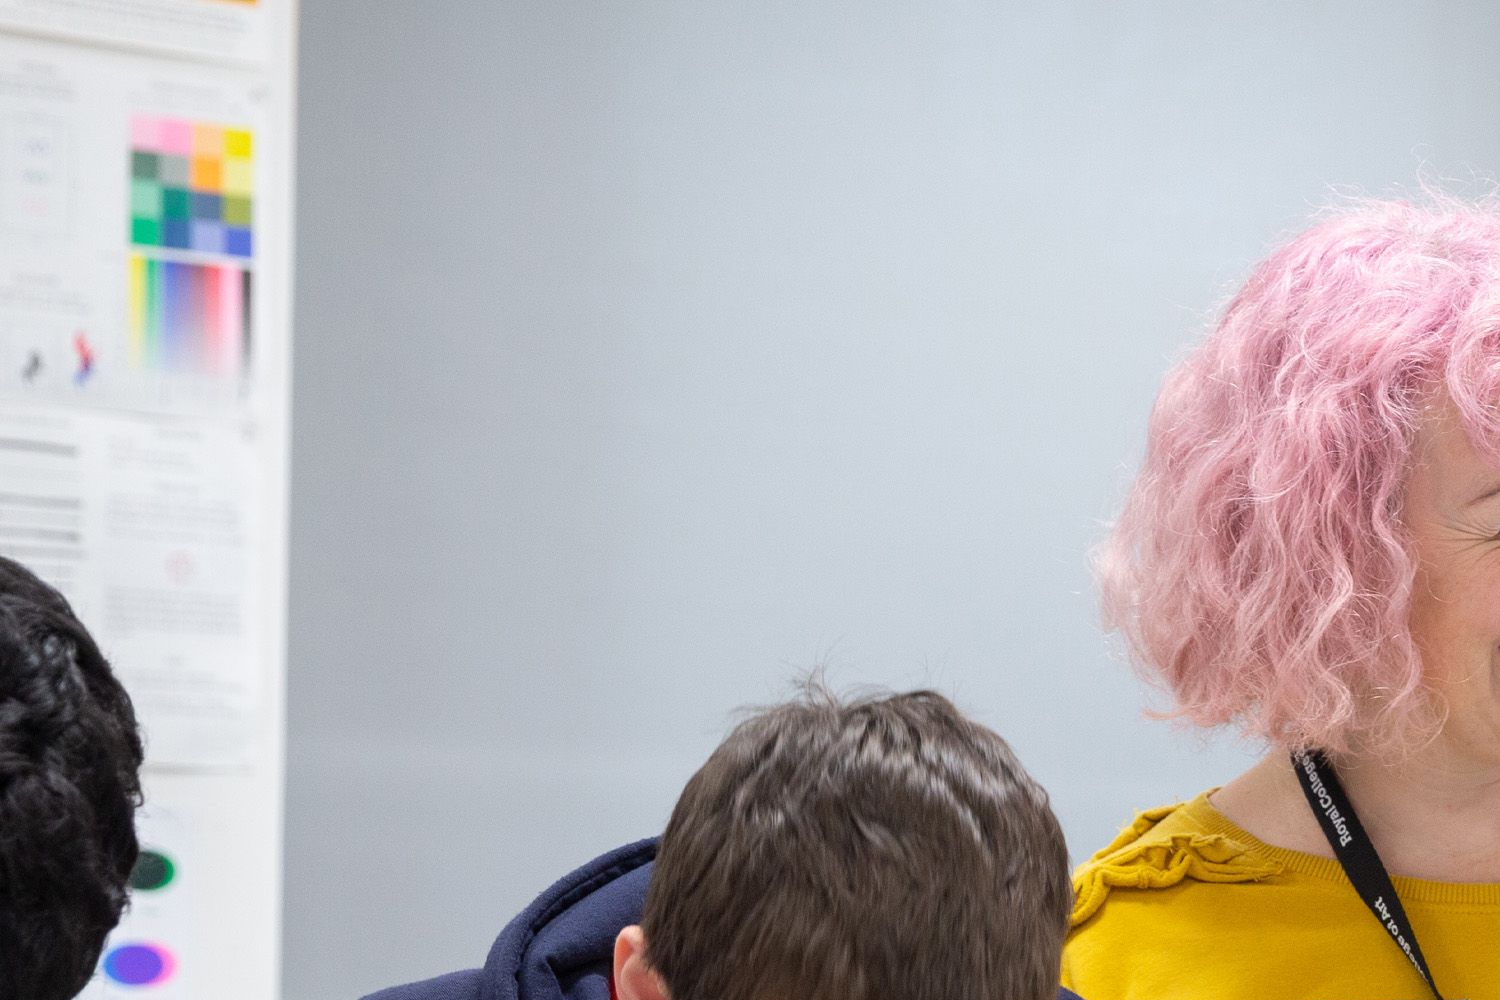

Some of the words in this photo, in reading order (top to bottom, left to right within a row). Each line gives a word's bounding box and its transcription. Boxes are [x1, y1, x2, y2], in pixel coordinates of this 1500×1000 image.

[1302, 755, 1333, 808] College
[1325, 805, 1353, 847] Royal
[1374, 895, 1391, 921] Art
